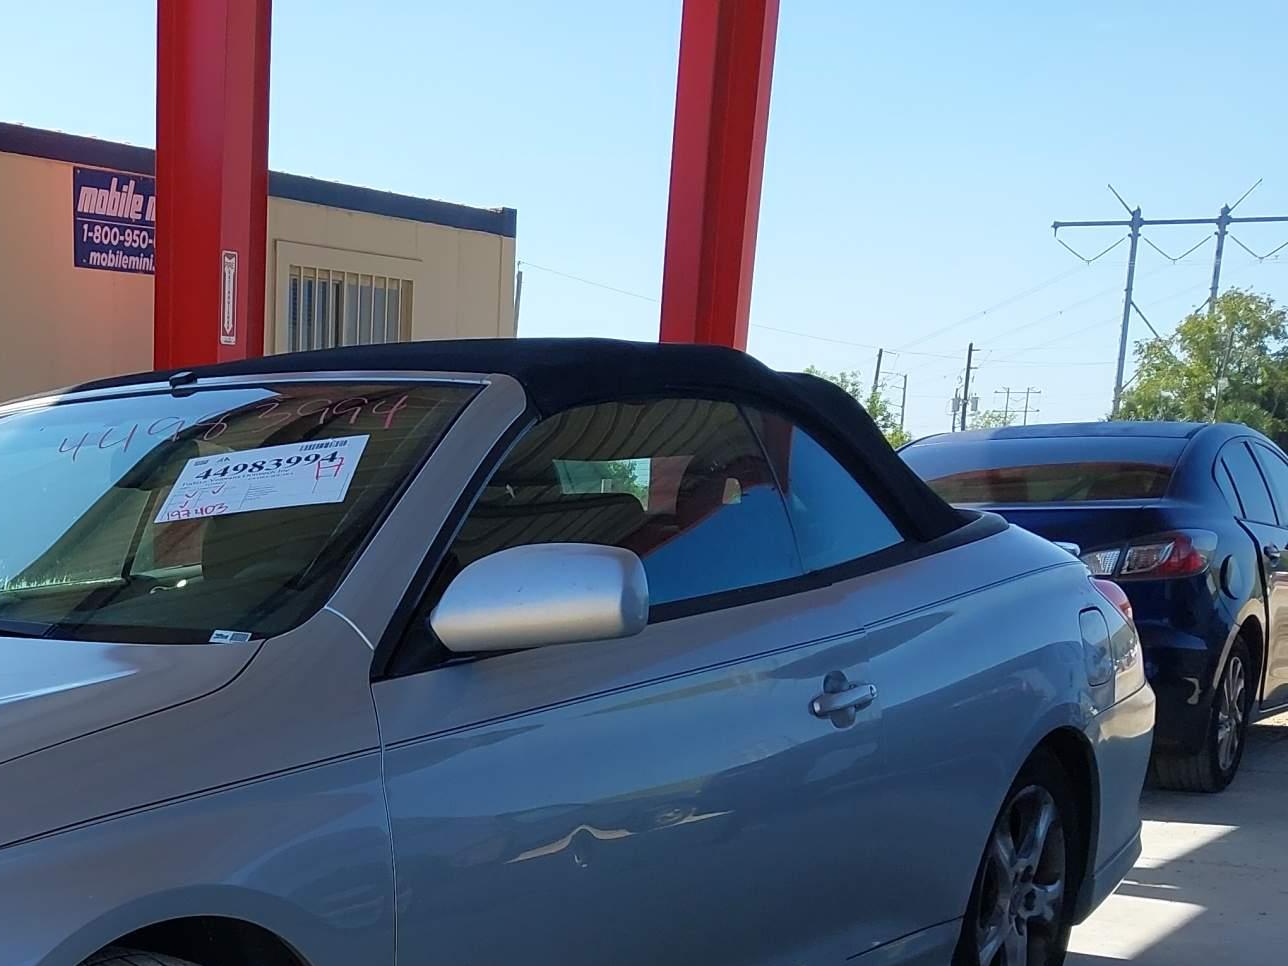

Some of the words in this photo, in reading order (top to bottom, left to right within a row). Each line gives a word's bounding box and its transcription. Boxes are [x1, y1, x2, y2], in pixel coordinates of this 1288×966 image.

[77, 177, 143, 220] mobile
[82, 223, 156, 249] 1-800-950-
[89, 250, 155, 271] mobilemini.
[195, 450, 339, 481] 44983994
